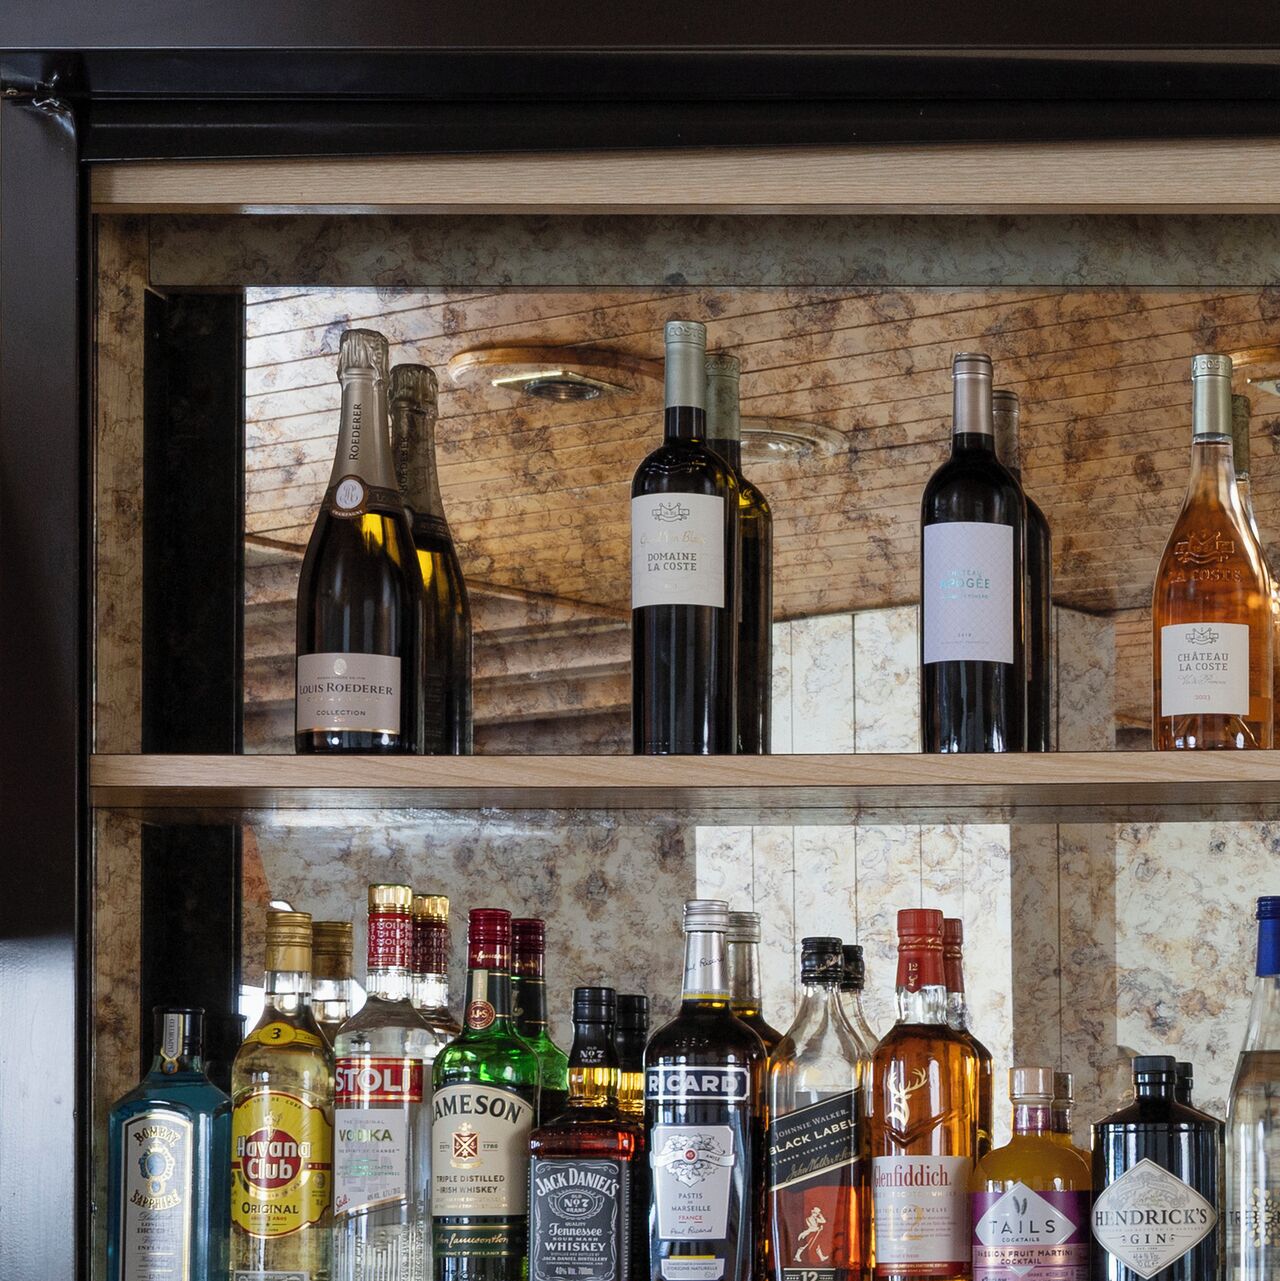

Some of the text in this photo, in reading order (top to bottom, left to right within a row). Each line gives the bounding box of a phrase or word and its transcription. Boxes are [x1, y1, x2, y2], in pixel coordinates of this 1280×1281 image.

[349, 403, 362, 461] ROEDERER
[647, 552, 697, 562] DOMAINE
[647, 562, 697, 572] LA COSTE
[1177, 650, 1229, 662] CHÂTEAU
[1179, 662, 1228, 672] LA COSTE
[300, 682, 393, 696] LOUIS ROEDERER
[316, 709, 366, 717] COLLECTION
[271, 1027, 282, 1040] 3
[335, 1067, 412, 1092] STOLI
[648, 1075, 739, 1093] RICARD
[133, 1126, 181, 1147] BOMBAY
[338, 1129, 393, 1142] VODKA
[776, 1120, 812, 1140] JOHNNIE
[768, 1119, 857, 1156] BLACK LABEL
[236, 1135, 312, 1159] Havana
[246, 1158, 294, 1180] Club
[436, 1175, 505, 1183] TRIPLE DISTILLED
[535, 1167, 620, 1198] JACK DANIEL'S
[459, 1186, 498, 1194] WHISKEY
[130, 1190, 182, 1212] SAPPHIRE
[241, 1201, 299, 1215] ORIGINAL
[1094, 1207, 1208, 1228] HENDRICK'S
[548, 1222, 603, 1237] Tennessee
[988, 1219, 1056, 1234] TAILS
[1130, 1233, 1167, 1245] GIN
[544, 1242, 606, 1252] WHISKEY
[1008, 1249, 1073, 1258] FRUIT MARTINI
